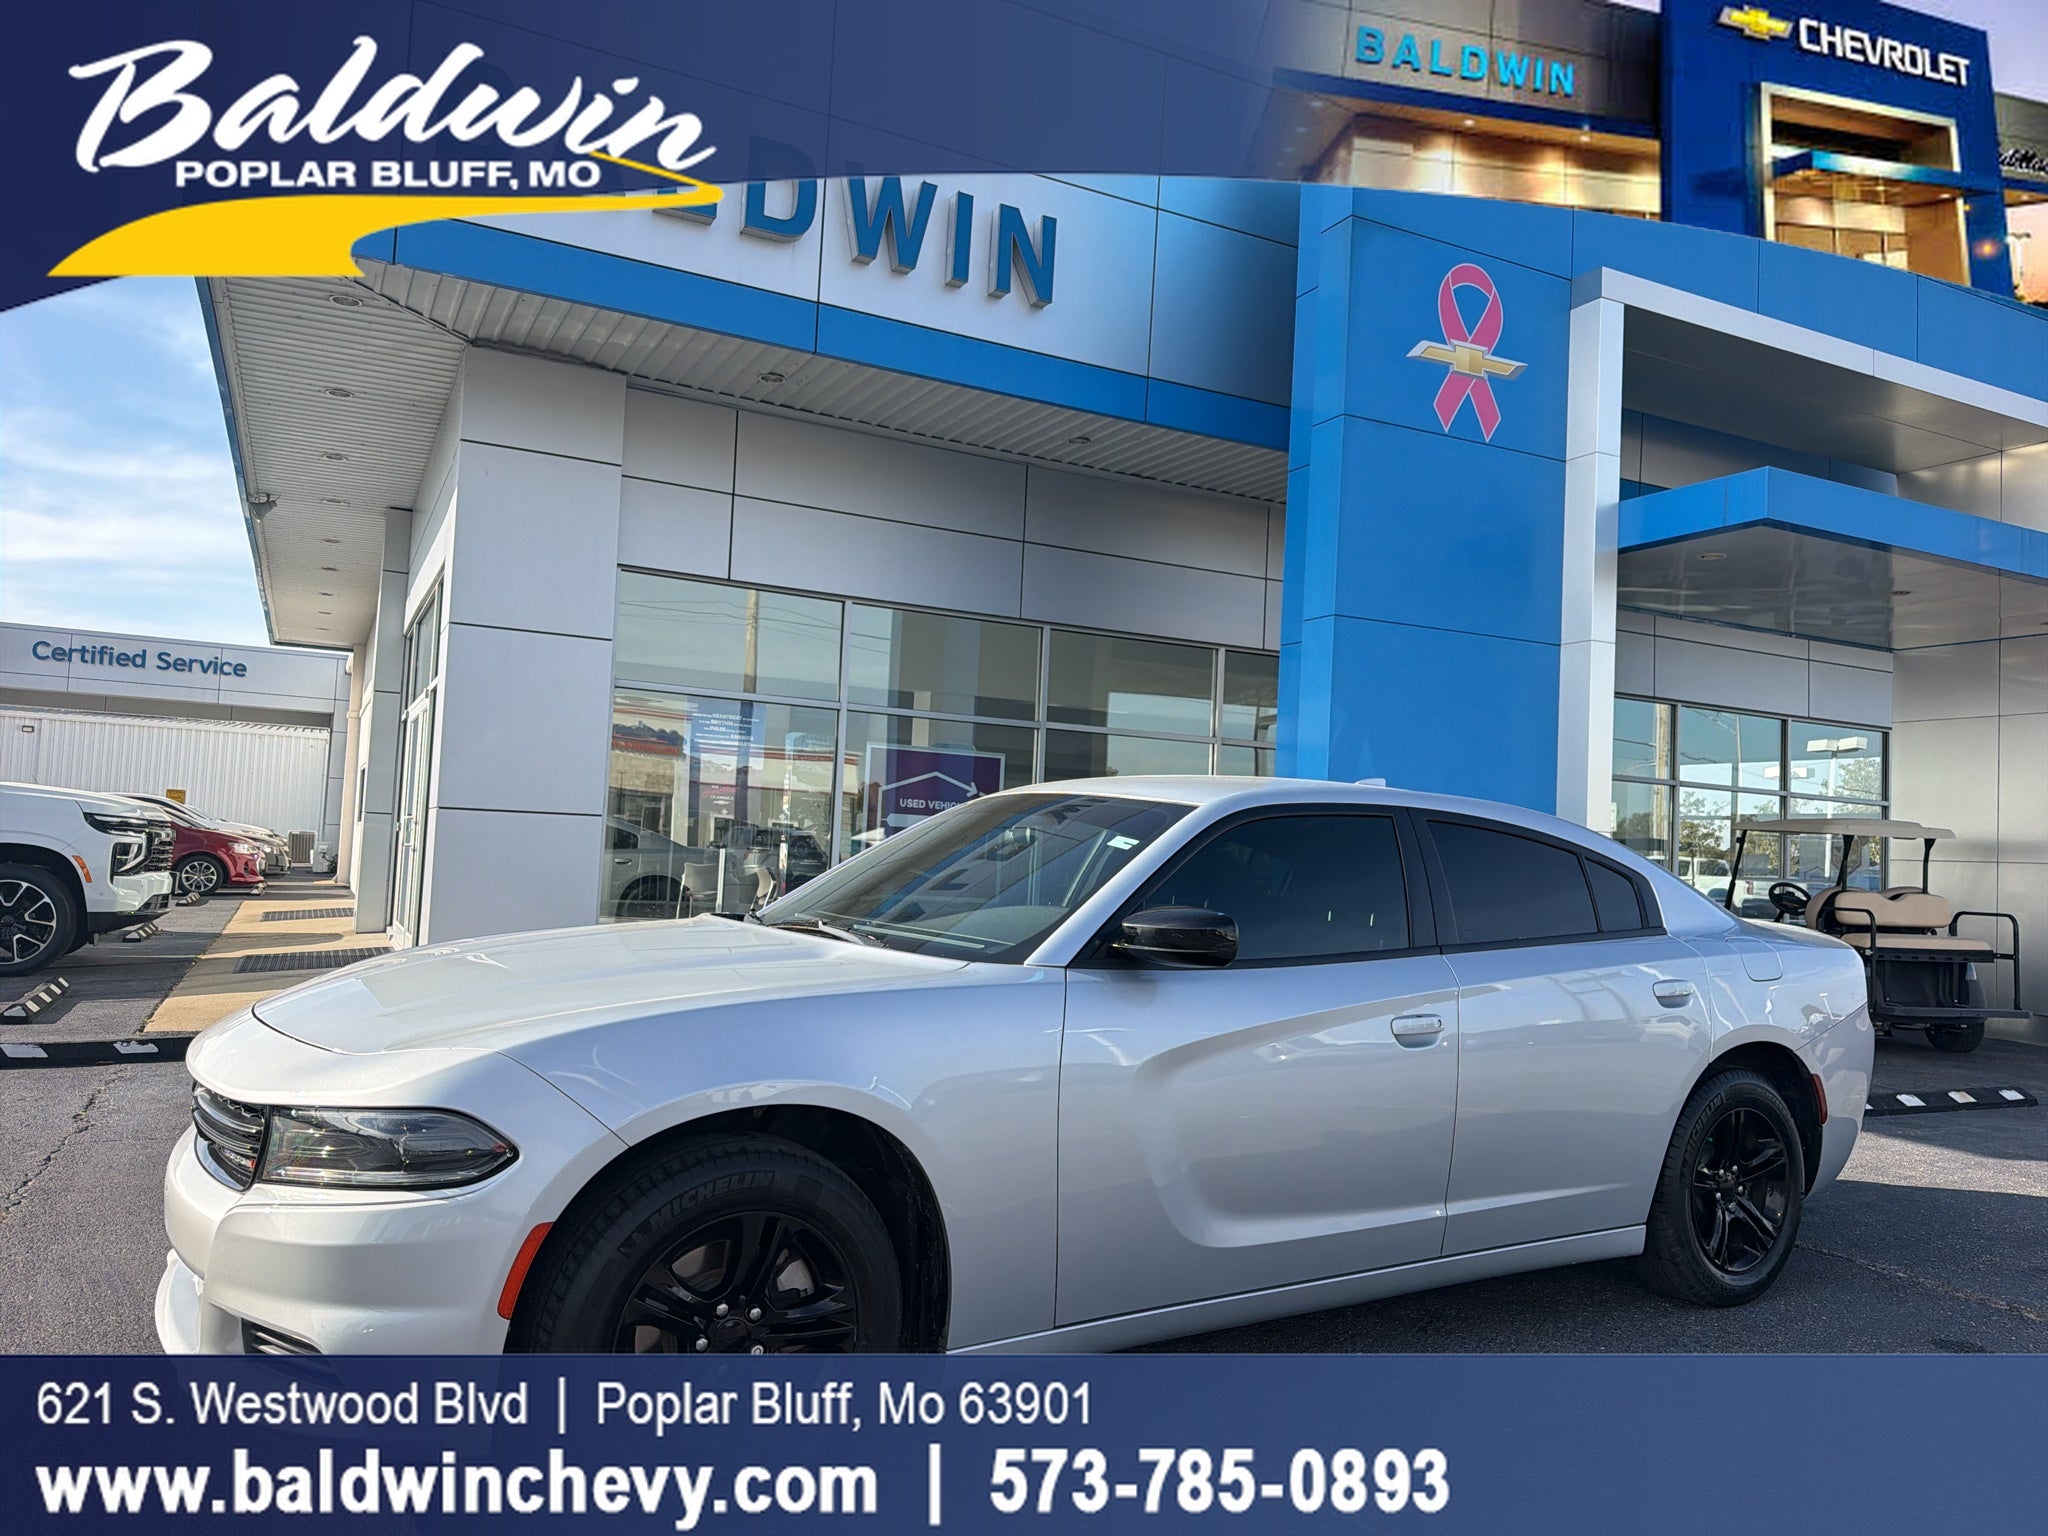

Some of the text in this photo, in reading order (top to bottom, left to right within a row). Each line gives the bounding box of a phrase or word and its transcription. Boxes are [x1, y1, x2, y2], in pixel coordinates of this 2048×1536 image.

[32, 640, 248, 677] Certified Service
[900, 798, 926, 808] USED
[650, 1170, 775, 1231] MICHELIN
